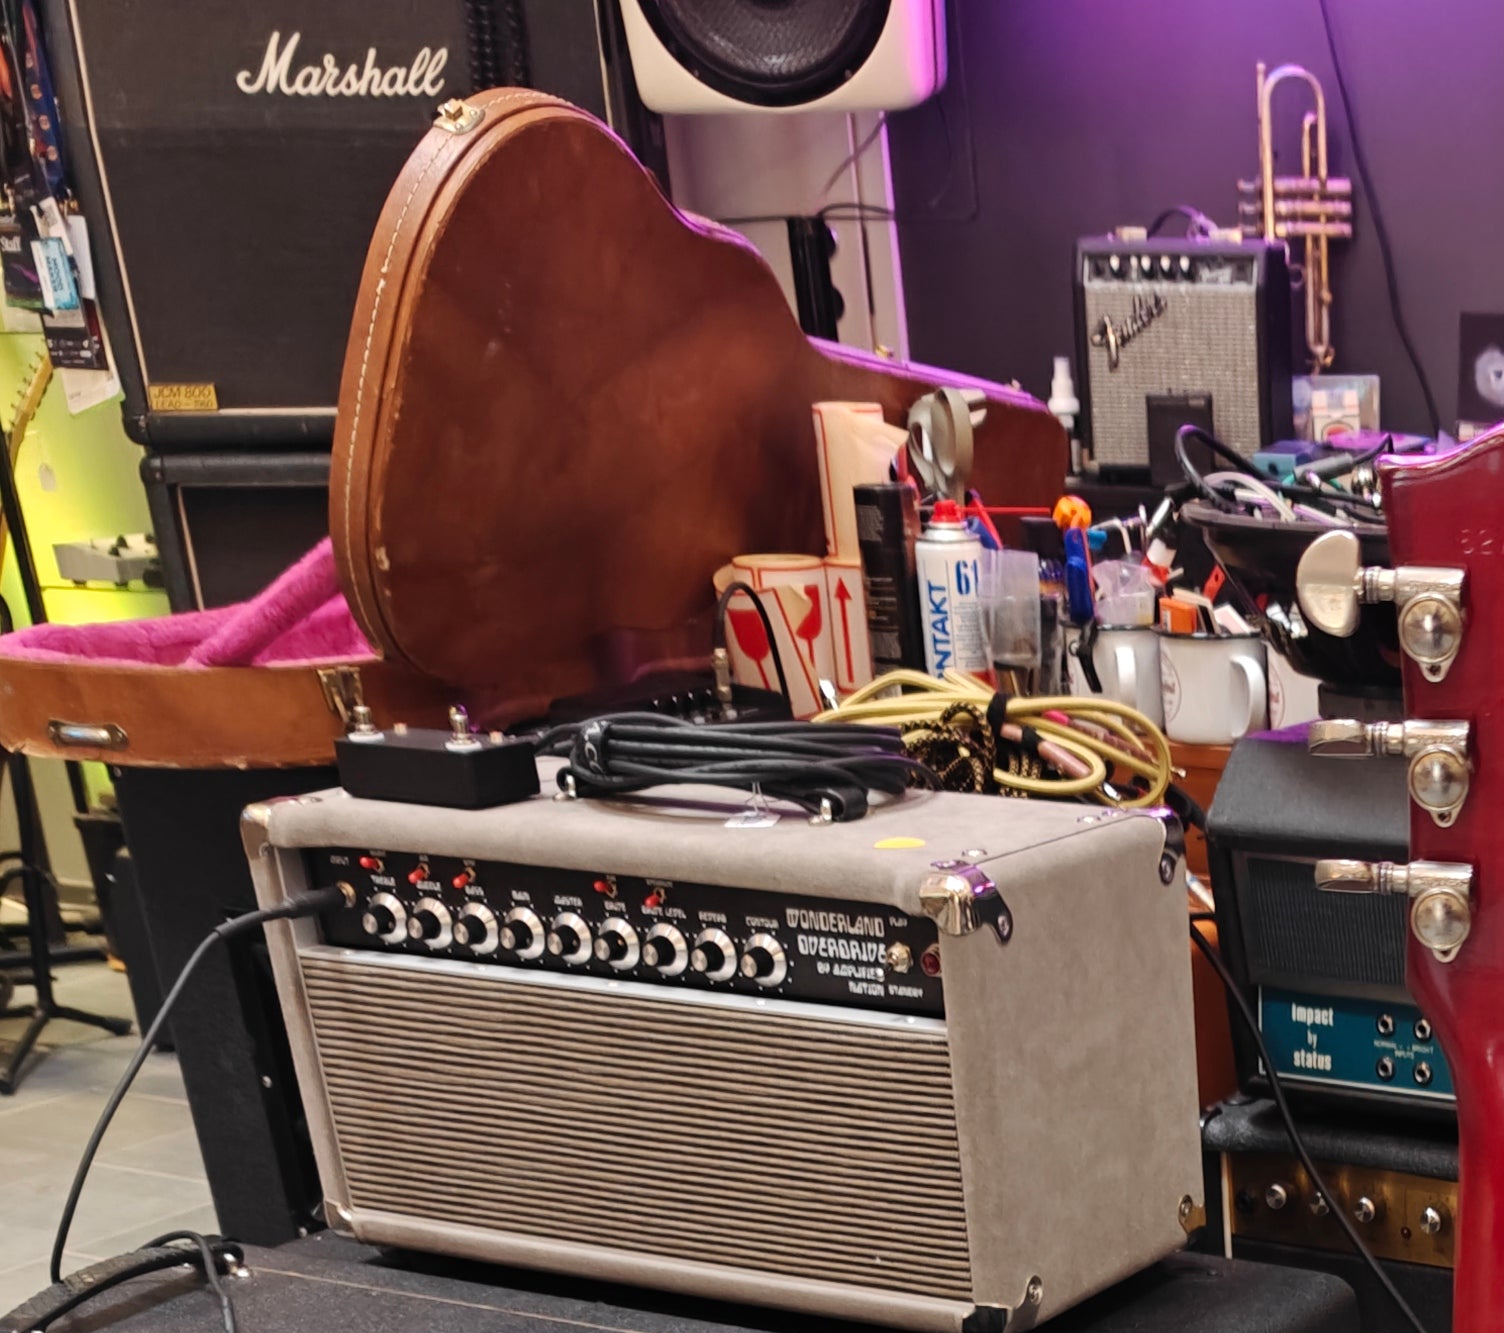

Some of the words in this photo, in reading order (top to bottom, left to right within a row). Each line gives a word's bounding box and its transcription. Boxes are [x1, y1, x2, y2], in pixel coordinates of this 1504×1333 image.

[236, 30, 448, 97] Marshall
[154, 387, 180, 399] JCM
[184, 386, 212, 399] 800
[928, 580, 951, 679] NTAKT
[785, 908, 885, 938] WONDERLAND
[797, 934, 887, 963] OVERDRIVE
[832, 963, 885, 980] AMPLIFIE
[1291, 1002, 1334, 1026] Impact
[1307, 1029, 1318, 1049] by
[1293, 1050, 1332, 1071] status
